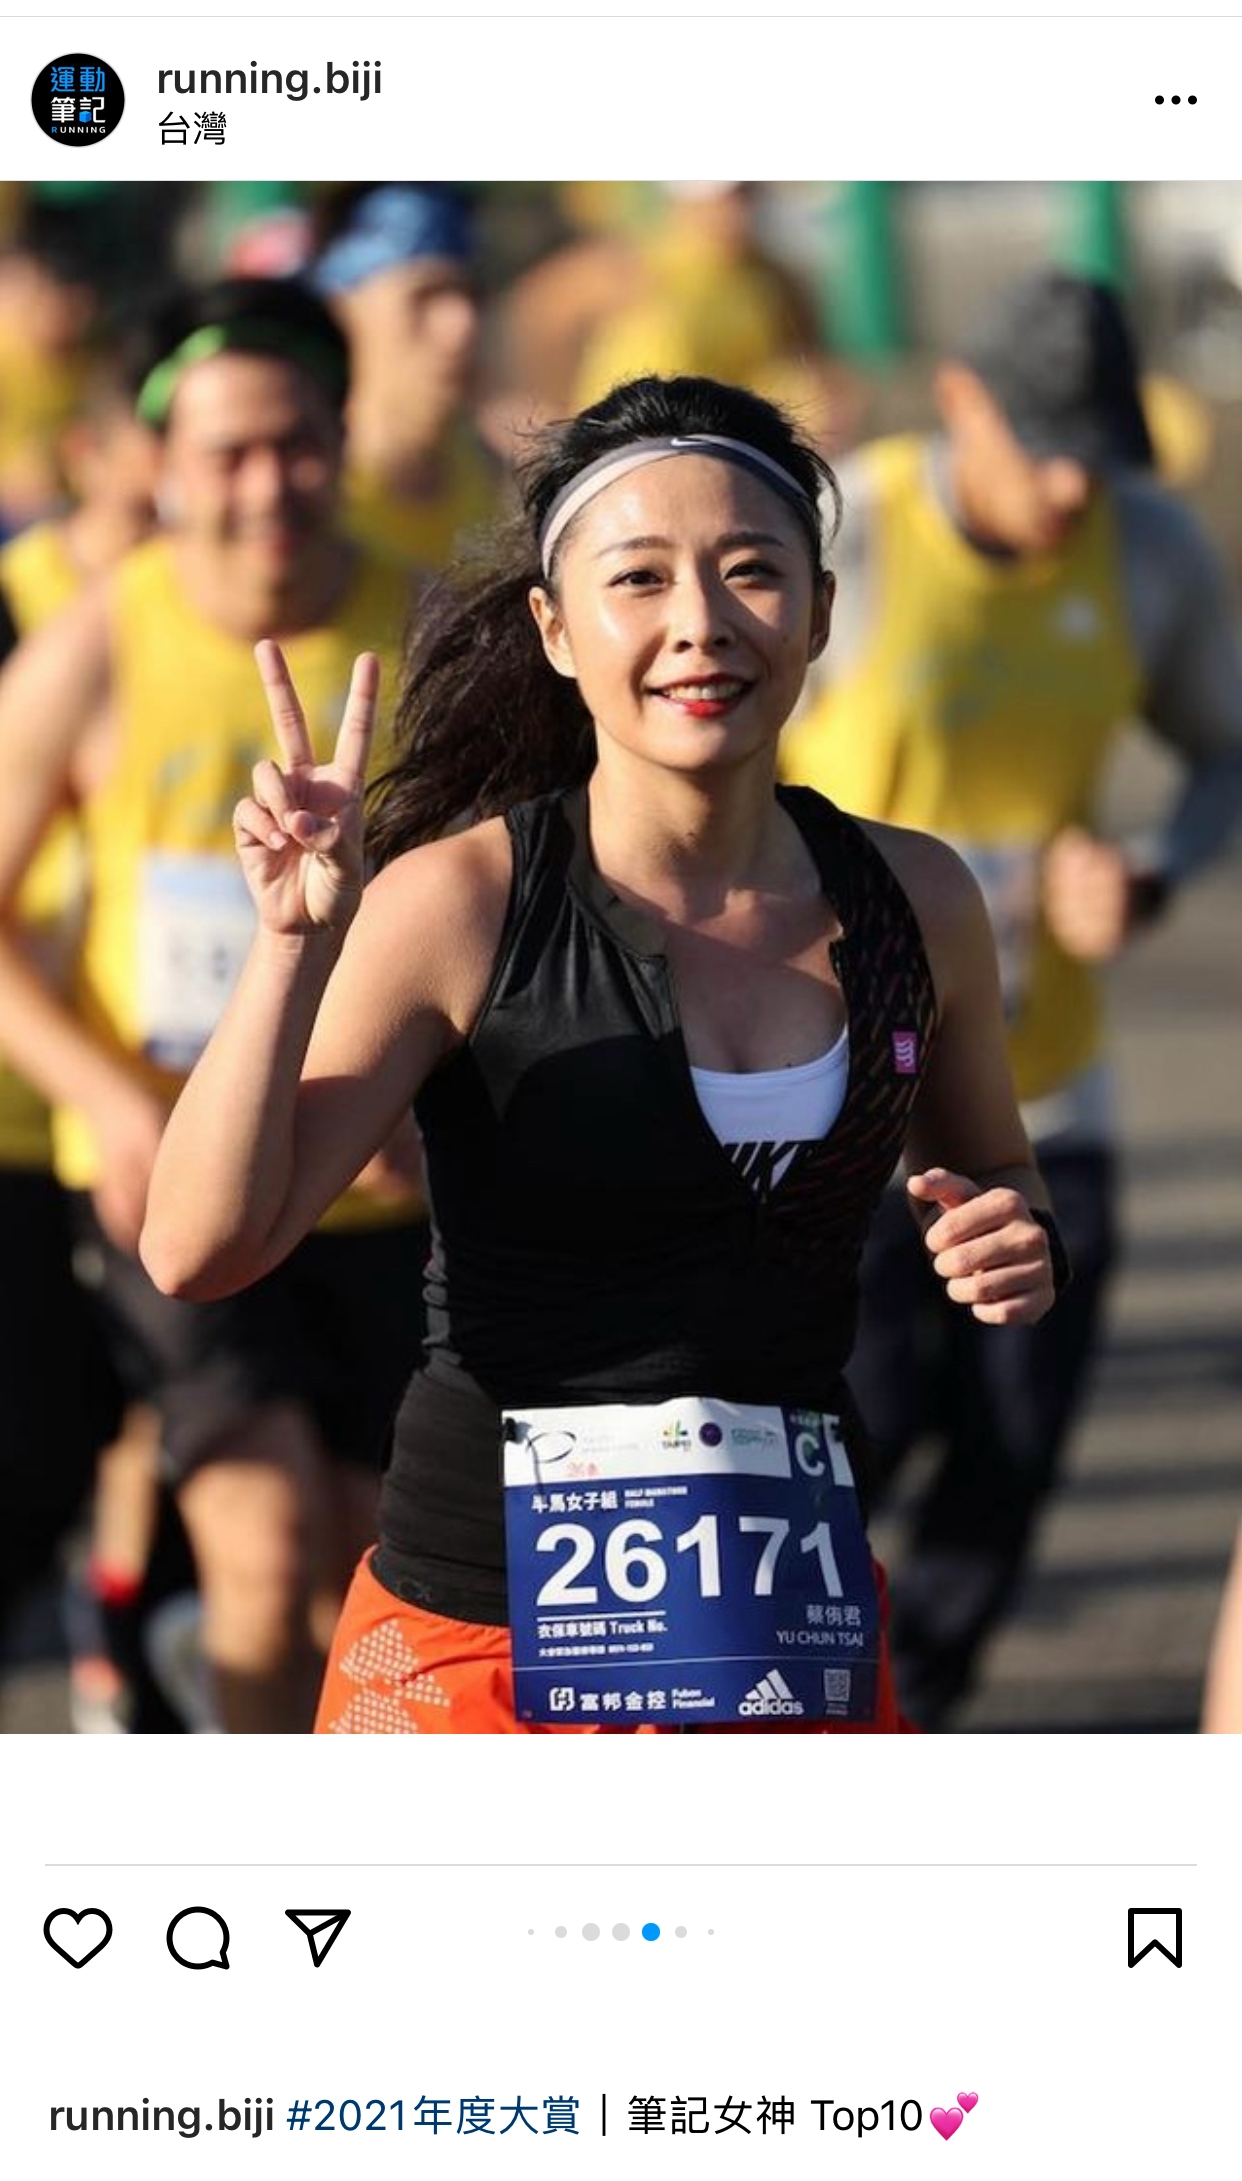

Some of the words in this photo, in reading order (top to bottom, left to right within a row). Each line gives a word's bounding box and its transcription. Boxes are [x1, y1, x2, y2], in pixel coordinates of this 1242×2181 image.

[536, 1514, 844, 1607] 26171
[609, 1619, 645, 1635] Truck
[776, 1630, 796, 1645] YU
[797, 1630, 836, 1646] CHUN
[837, 1631, 864, 1648] TSAI
[580, 1691, 667, 1712] 富邦金控
[738, 1697, 804, 1716] adidas
